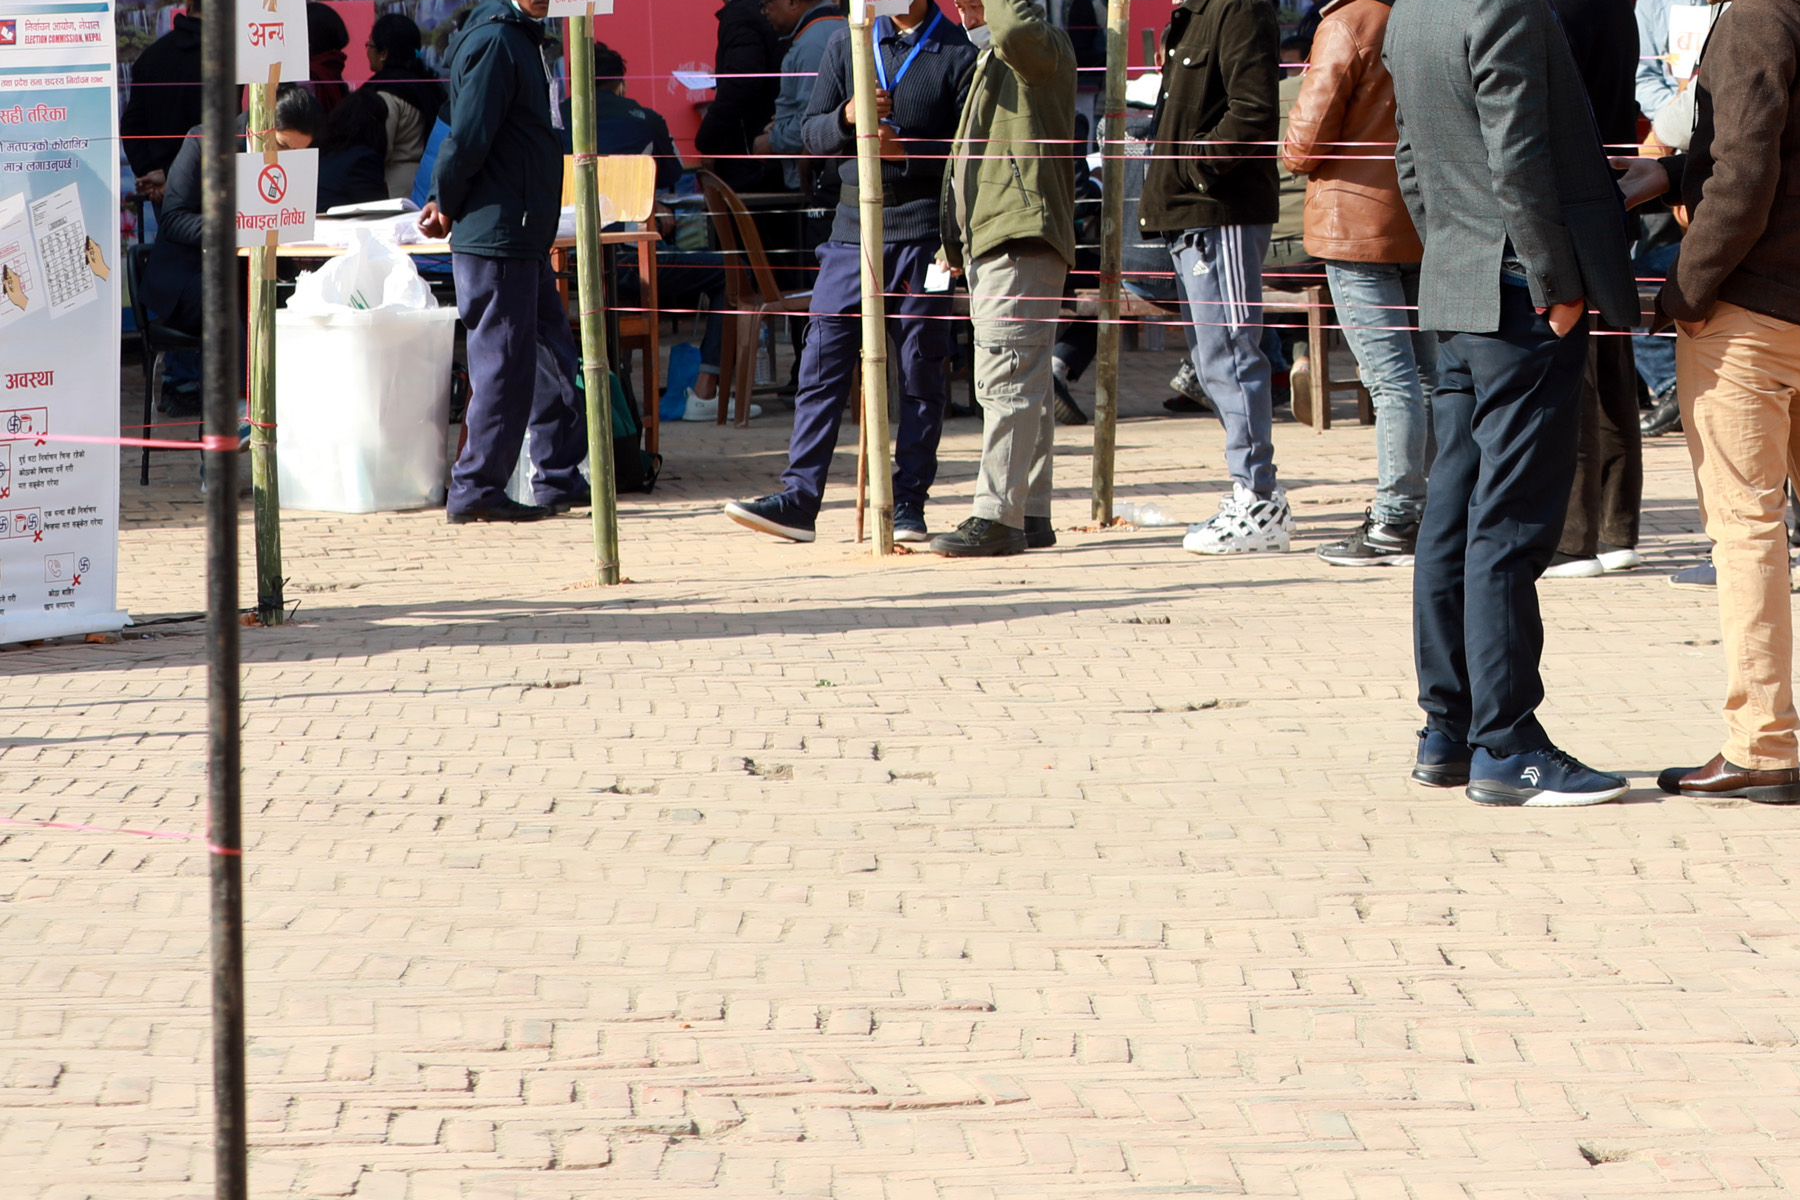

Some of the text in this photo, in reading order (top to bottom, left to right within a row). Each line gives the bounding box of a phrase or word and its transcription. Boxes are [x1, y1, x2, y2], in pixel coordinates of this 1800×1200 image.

[25, 19, 50, 32] निर्वाचन
[79, 18, 100, 30] नेपाल
[25, 35, 47, 45] ELECTION
[84, 33, 102, 42] NEPAL
[248, 22, 285, 48] अन्य
[0, 103, 67, 125] सही तरिका
[6, 139, 49, 152] मतपत्रको
[51, 137, 88, 150] कोठाभित्र
[3, 162, 23, 172] मात्र
[280, 208, 306, 227] निषेध
[5, 370, 54, 390] अवस्था
